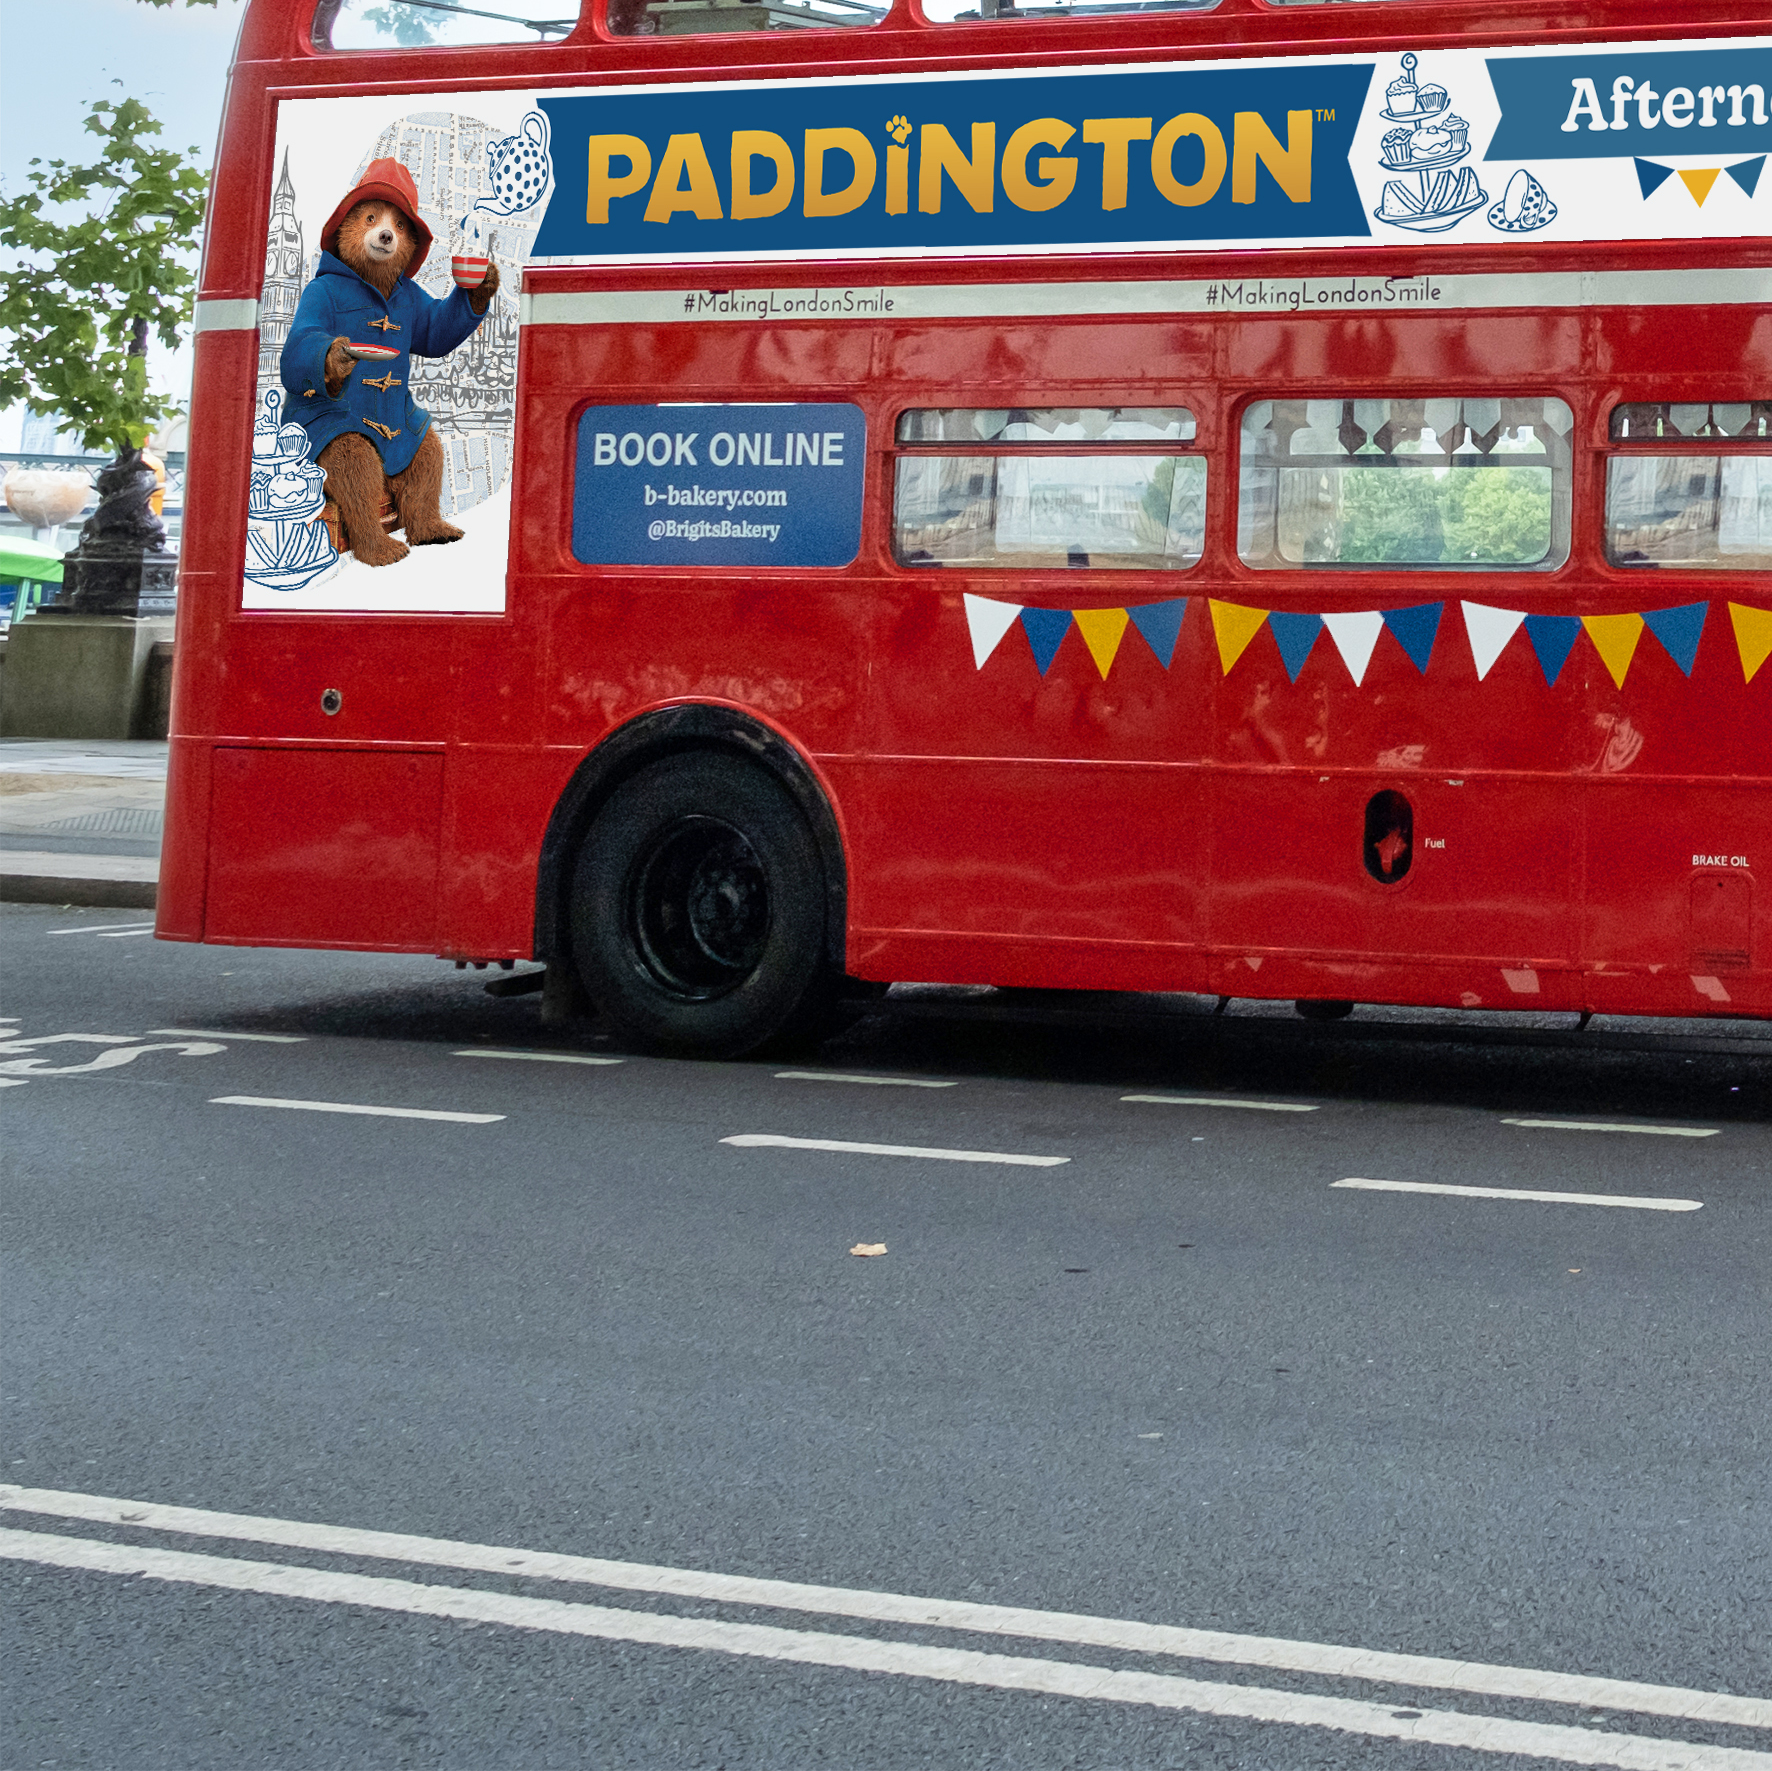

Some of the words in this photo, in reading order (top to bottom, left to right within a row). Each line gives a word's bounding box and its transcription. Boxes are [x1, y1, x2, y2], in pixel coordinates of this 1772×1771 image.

[685, 289, 894, 319] #MakingLondonSmile
[1206, 277, 1441, 311] #MakingLondonSmile
[594, 432, 699, 466] BOOK
[709, 432, 844, 466] ONLINE
[644, 485, 787, 511] b-bakery.com
[648, 520, 780, 542] @BrigitsBakery
[1425, 838, 1445, 848] Fuel
[1692, 855, 1728, 866] BRAKE
[1730, 856, 1749, 867] OIL
